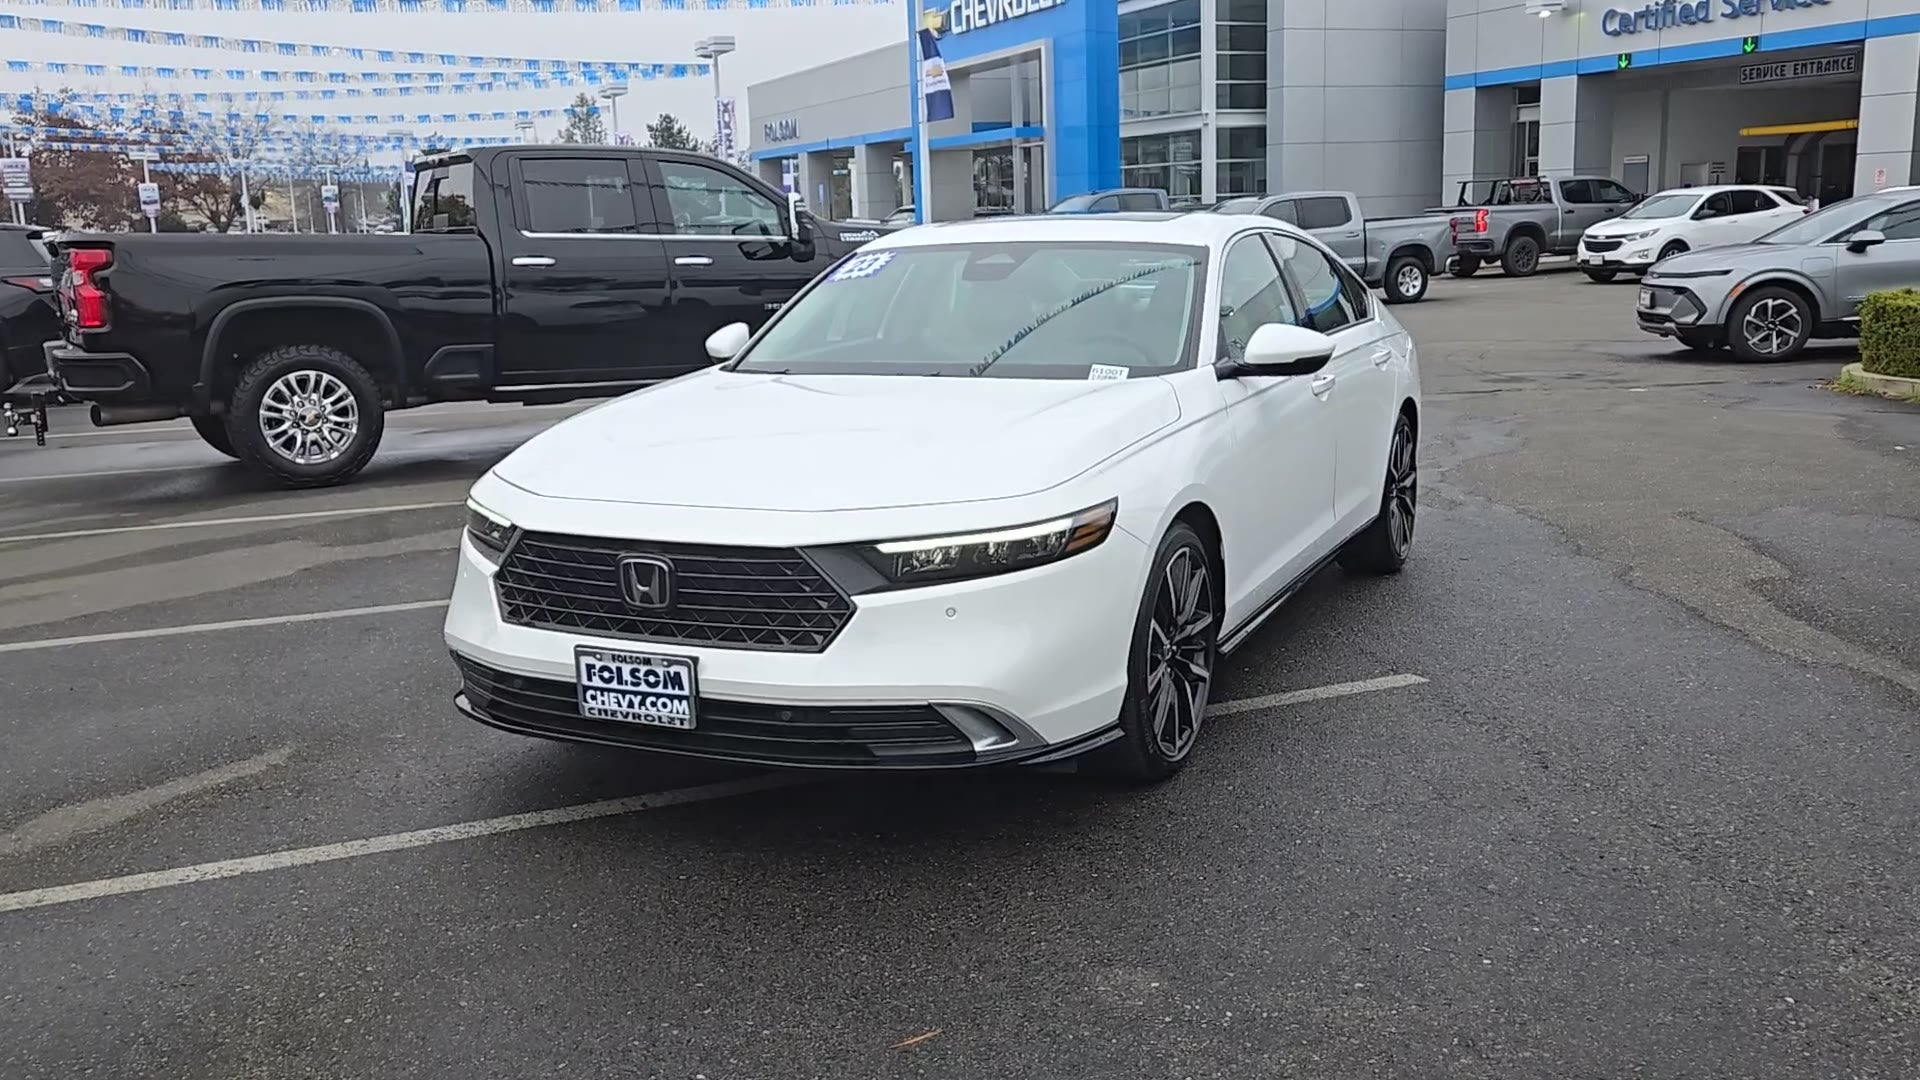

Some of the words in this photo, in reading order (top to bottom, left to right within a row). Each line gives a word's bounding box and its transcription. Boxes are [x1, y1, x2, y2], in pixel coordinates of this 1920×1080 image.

[950, 0, 1065, 34] CHEVRO
[1602, 0, 1712, 35] Certified
[1741, 64, 1787, 81] SERVICE
[1793, 56, 1854, 76] ENTRANCE
[764, 117, 800, 142] FOLSOM
[611, 654, 653, 666] FOLSOM
[586, 664, 685, 690] FOLSOM
[586, 691, 689, 715] CHEVY.COM
[588, 708, 687, 725] CHEVROLET
